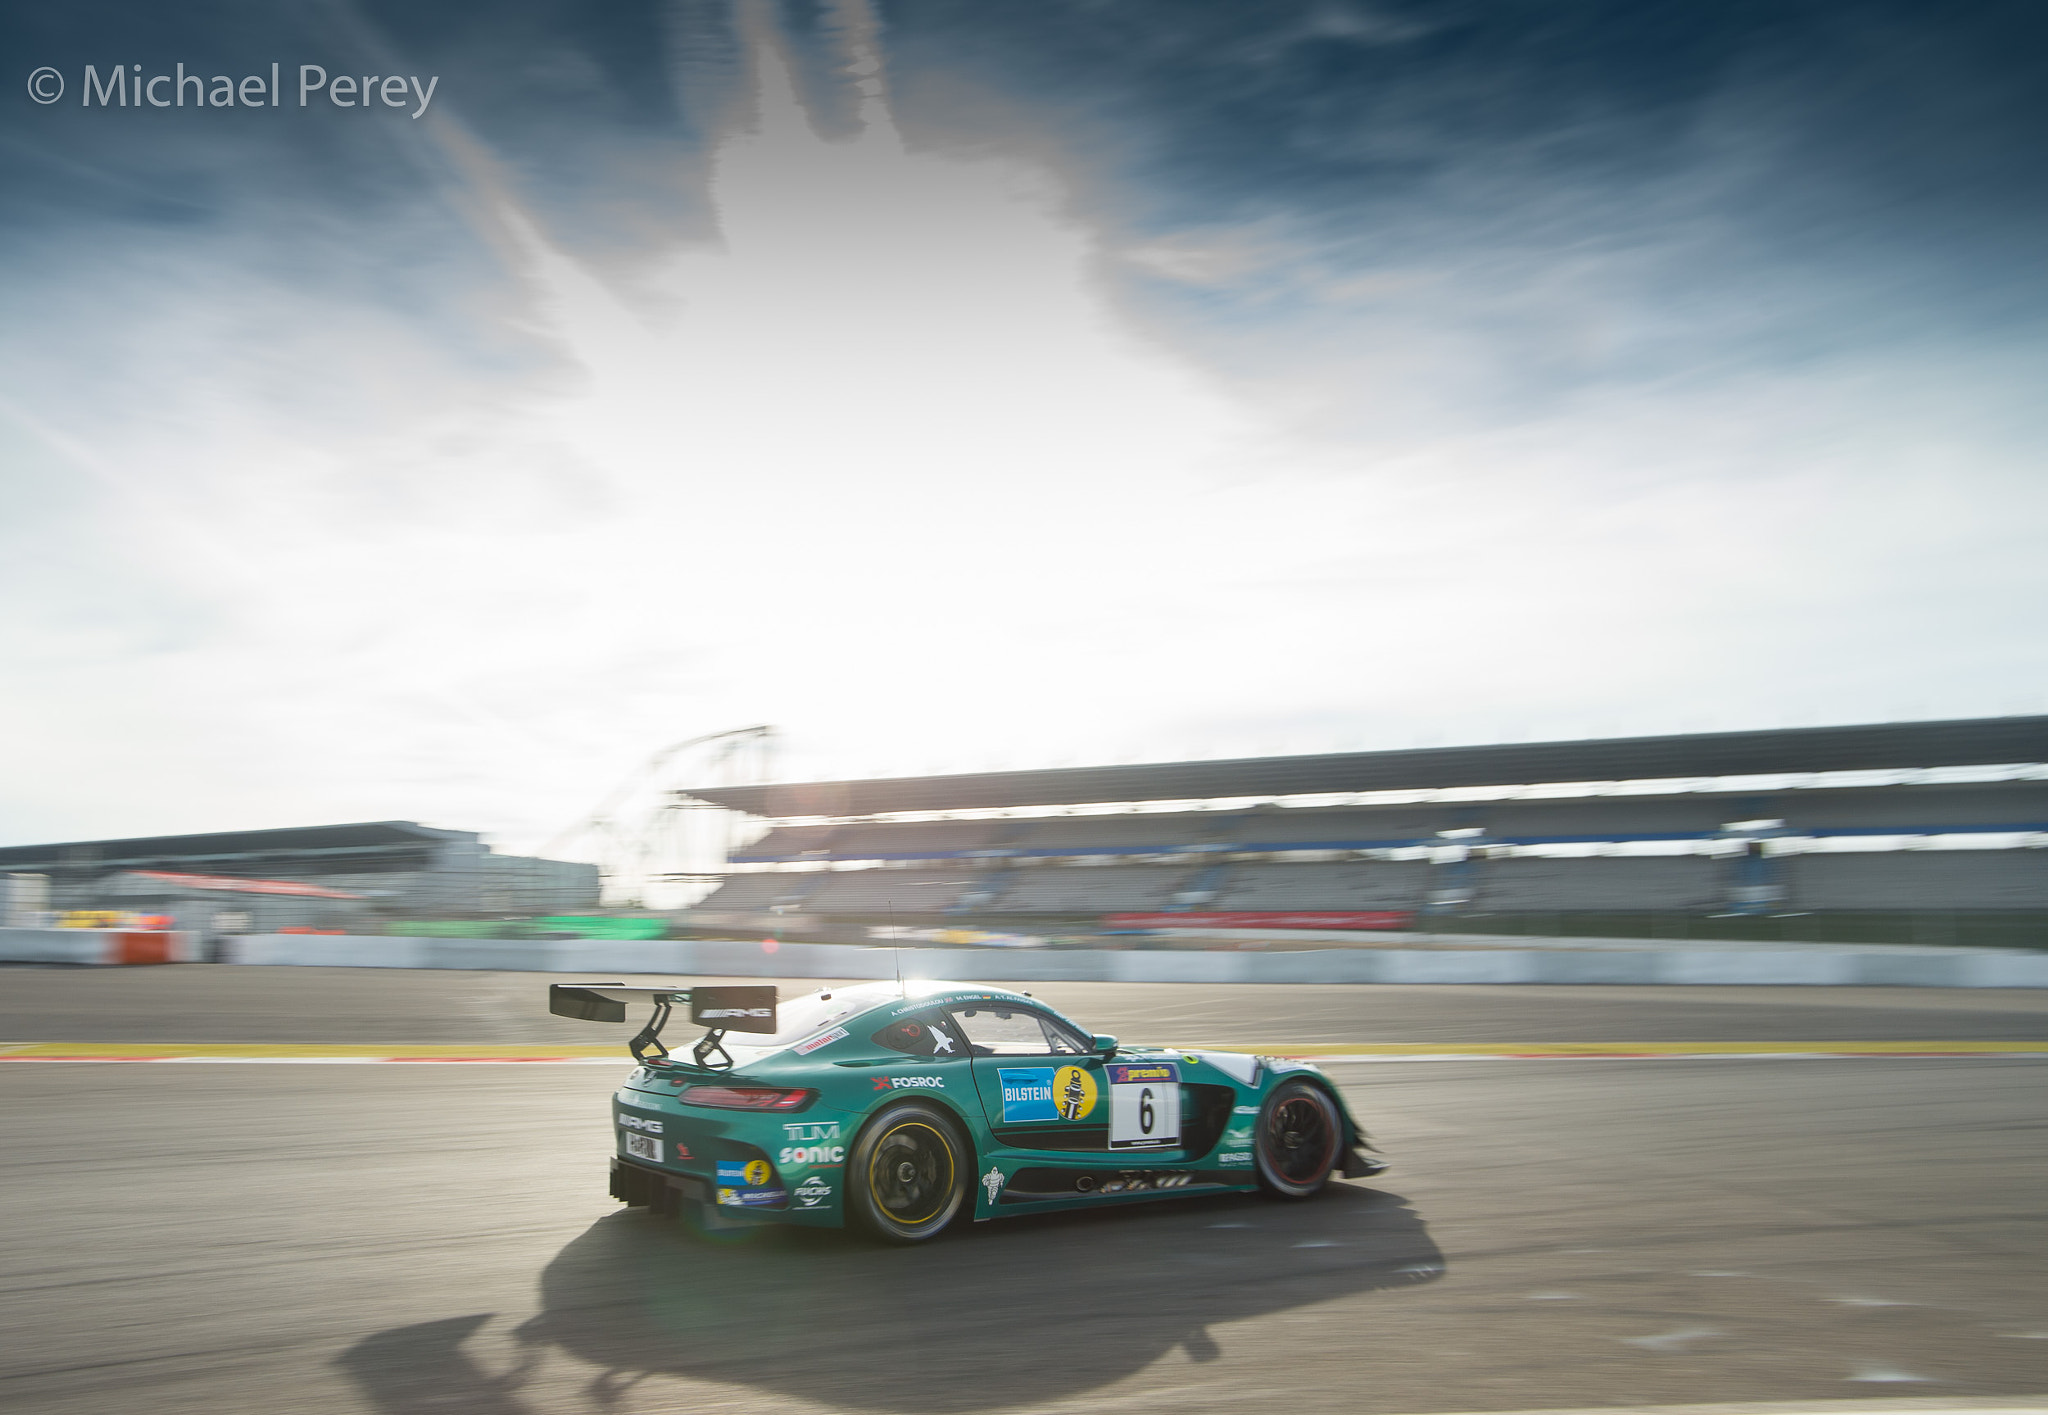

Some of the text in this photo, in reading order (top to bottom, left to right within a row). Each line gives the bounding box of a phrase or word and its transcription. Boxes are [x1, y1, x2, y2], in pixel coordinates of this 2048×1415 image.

[891, 1077, 945, 1088] FOSROC
[1005, 1086, 1052, 1102] BILSTEIN
[1140, 1087, 1155, 1135] 6
[793, 1186, 833, 1196] FUCHS
